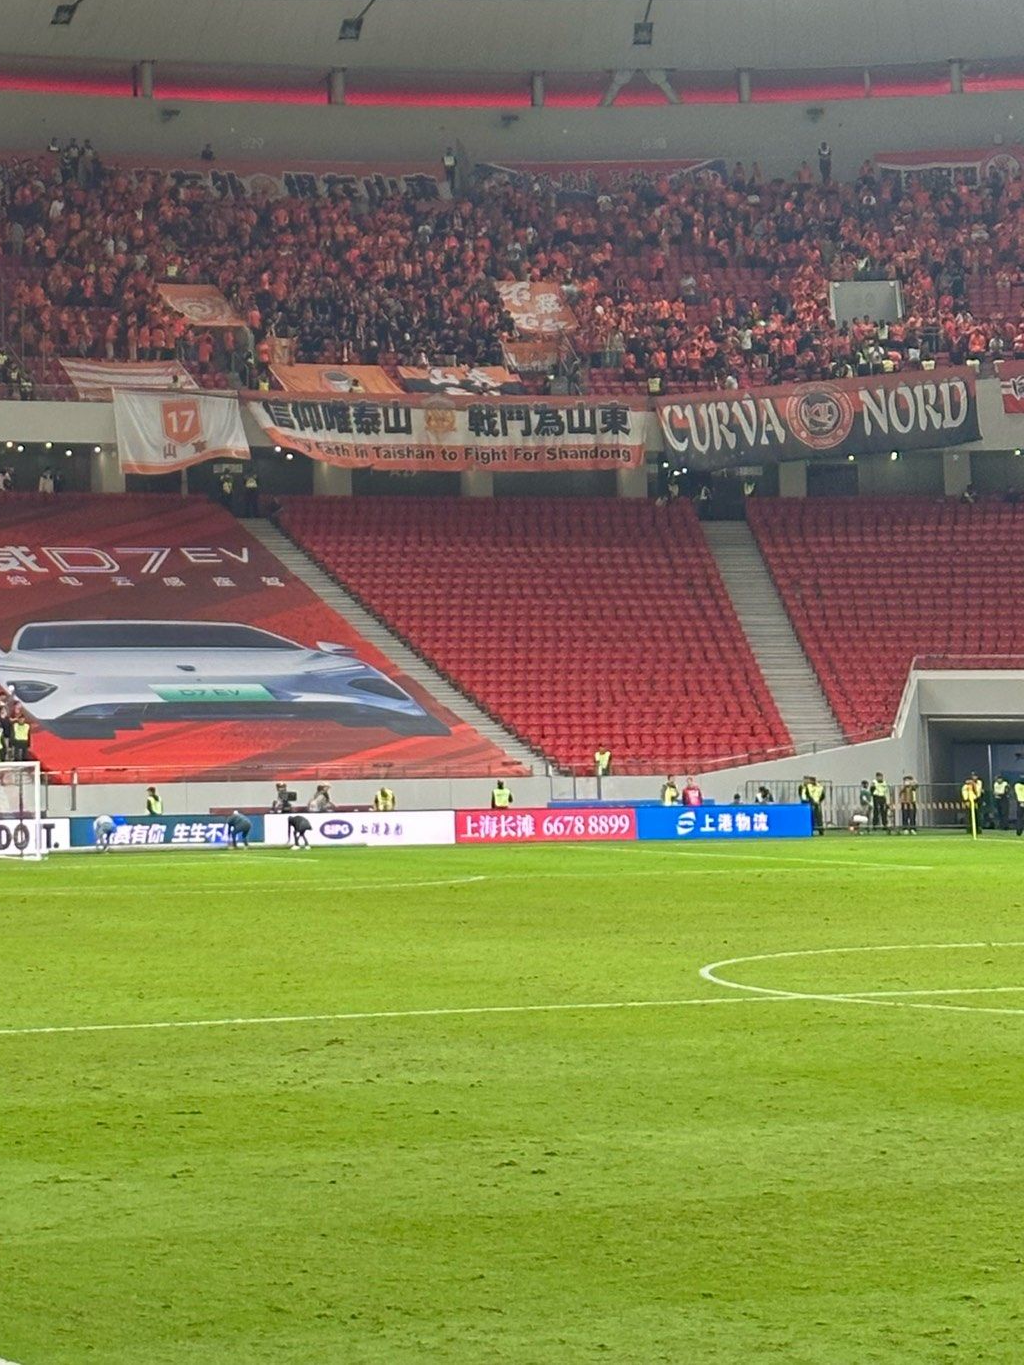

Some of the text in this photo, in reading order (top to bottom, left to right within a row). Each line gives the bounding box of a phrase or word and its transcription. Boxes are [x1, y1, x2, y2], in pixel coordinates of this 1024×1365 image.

[167, 410, 195, 433] 17
[661, 397, 785, 454] CURVA
[859, 381, 969, 436] NORD
[372, 446, 435, 461] Taishan
[441, 448, 458, 461] to
[465, 447, 507, 464] Fight
[513, 448, 540, 461] For
[546, 446, 632, 464] Shandong
[461, 814, 630, 838] 上海长滩 6678 8899
[700, 812, 769, 832] 上港物流
